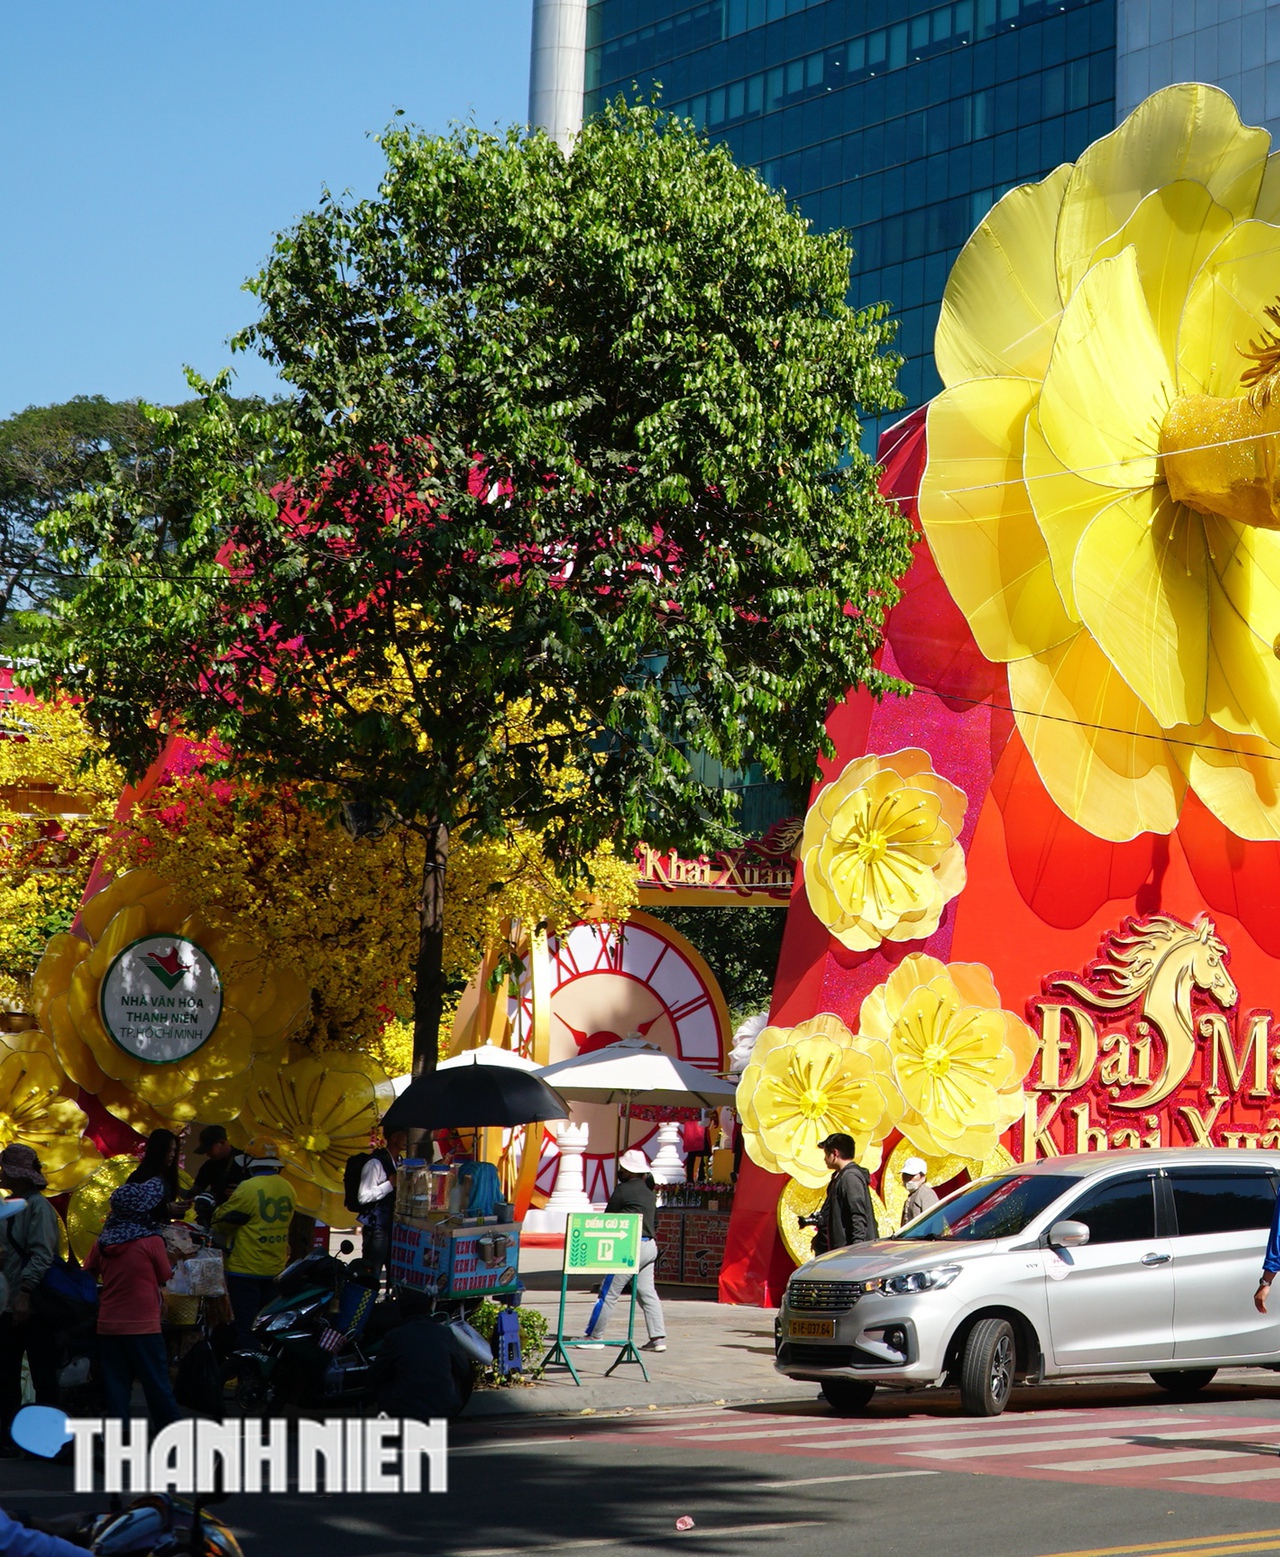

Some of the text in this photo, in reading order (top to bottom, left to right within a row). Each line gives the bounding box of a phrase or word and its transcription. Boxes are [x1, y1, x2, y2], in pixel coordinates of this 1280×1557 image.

[639, 842, 712, 888] Khai
[121, 995, 204, 1009] NHÀ VĂN HÓA
[127, 1012, 198, 1024] THANH NIÊN
[1035, 1004, 1153, 1098] Đại
[257, 1188, 293, 1223] be
[600, 1243, 612, 1258] P
